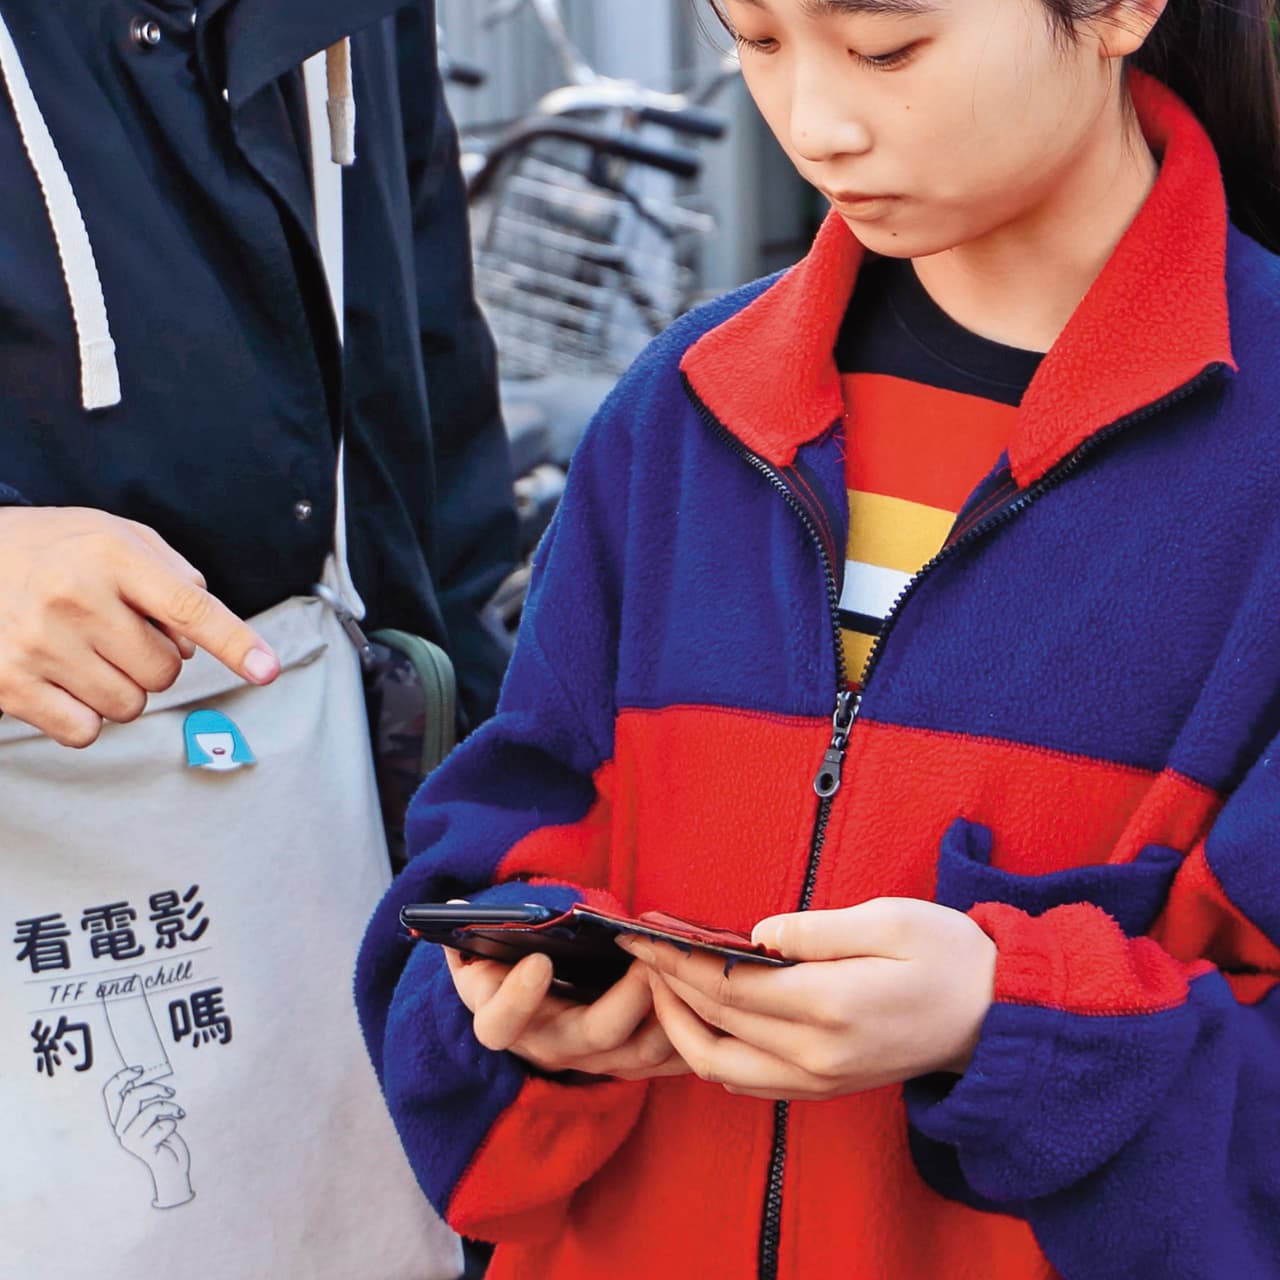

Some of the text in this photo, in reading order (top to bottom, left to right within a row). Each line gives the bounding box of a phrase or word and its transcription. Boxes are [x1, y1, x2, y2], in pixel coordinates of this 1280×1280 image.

[13, 884, 210, 974] 看電影
[49, 960, 194, 1004] TFF and chill
[30, 986, 234, 1077] 約 嗎
